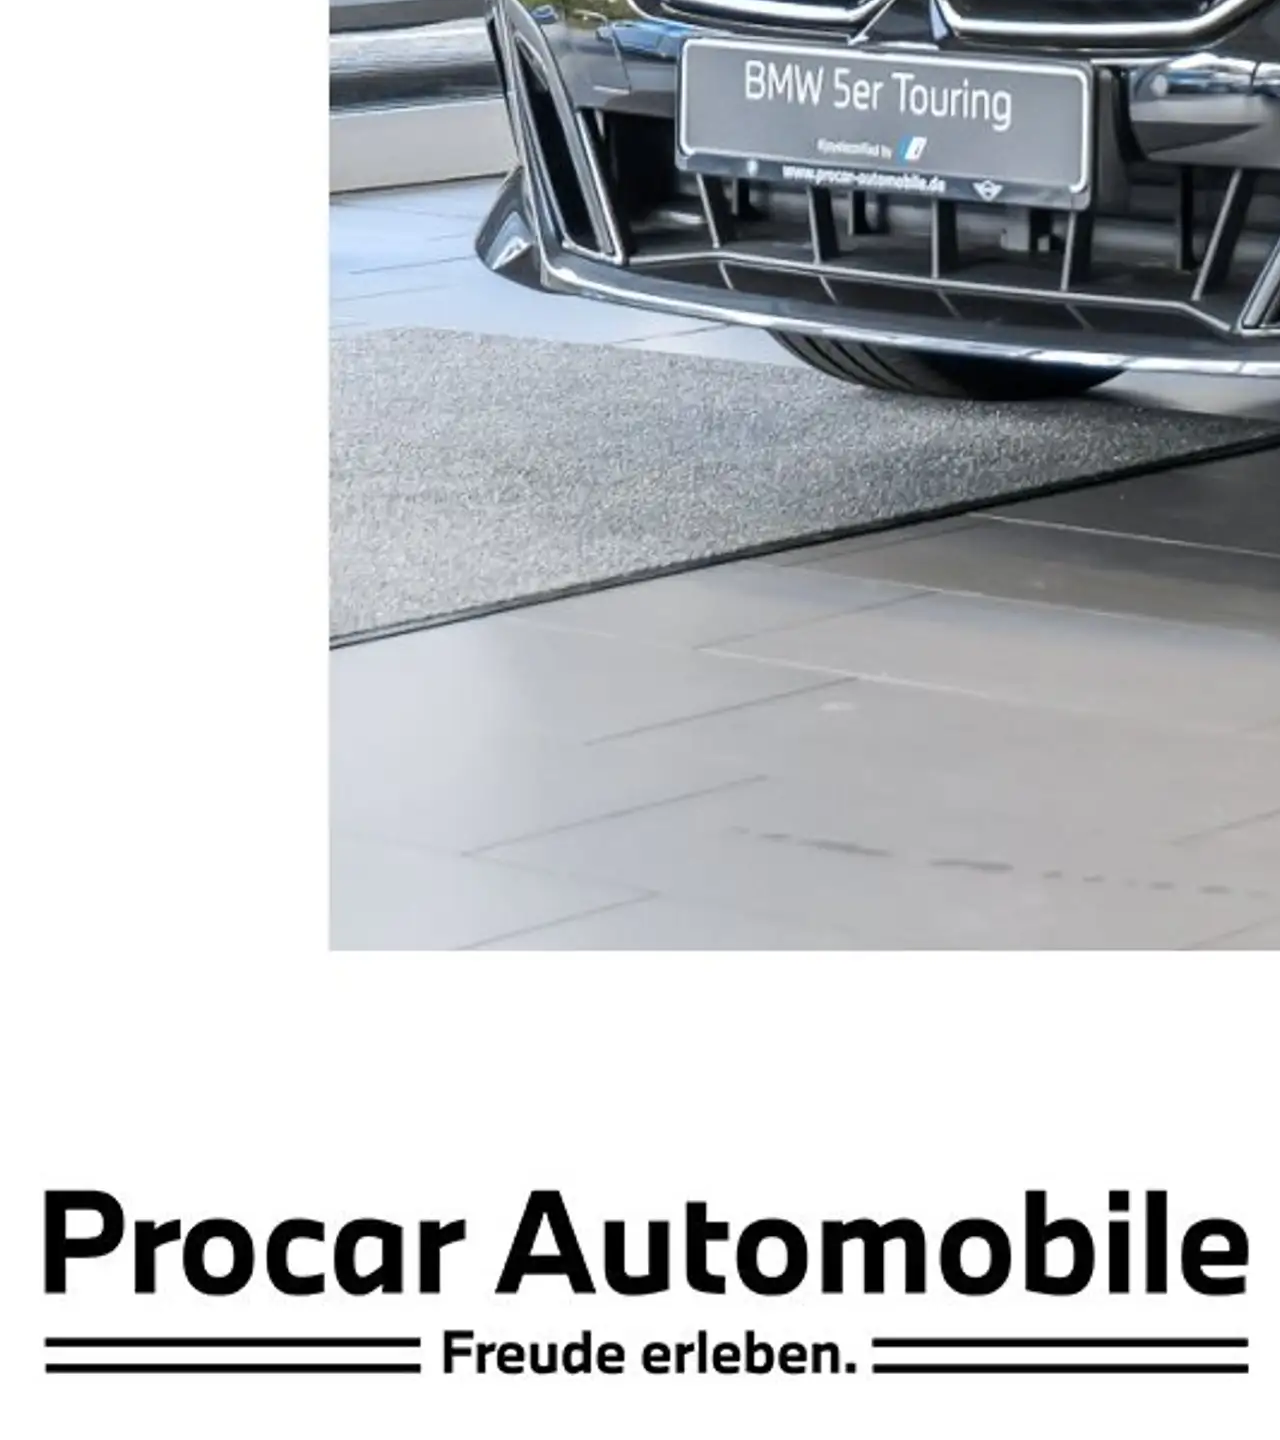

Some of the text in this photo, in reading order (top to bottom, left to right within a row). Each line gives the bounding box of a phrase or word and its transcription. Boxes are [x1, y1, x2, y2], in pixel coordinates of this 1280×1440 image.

[745, 59, 1012, 132] BMW 5er Touring
[782, 164, 947, 194] www.procar-automobile.de
